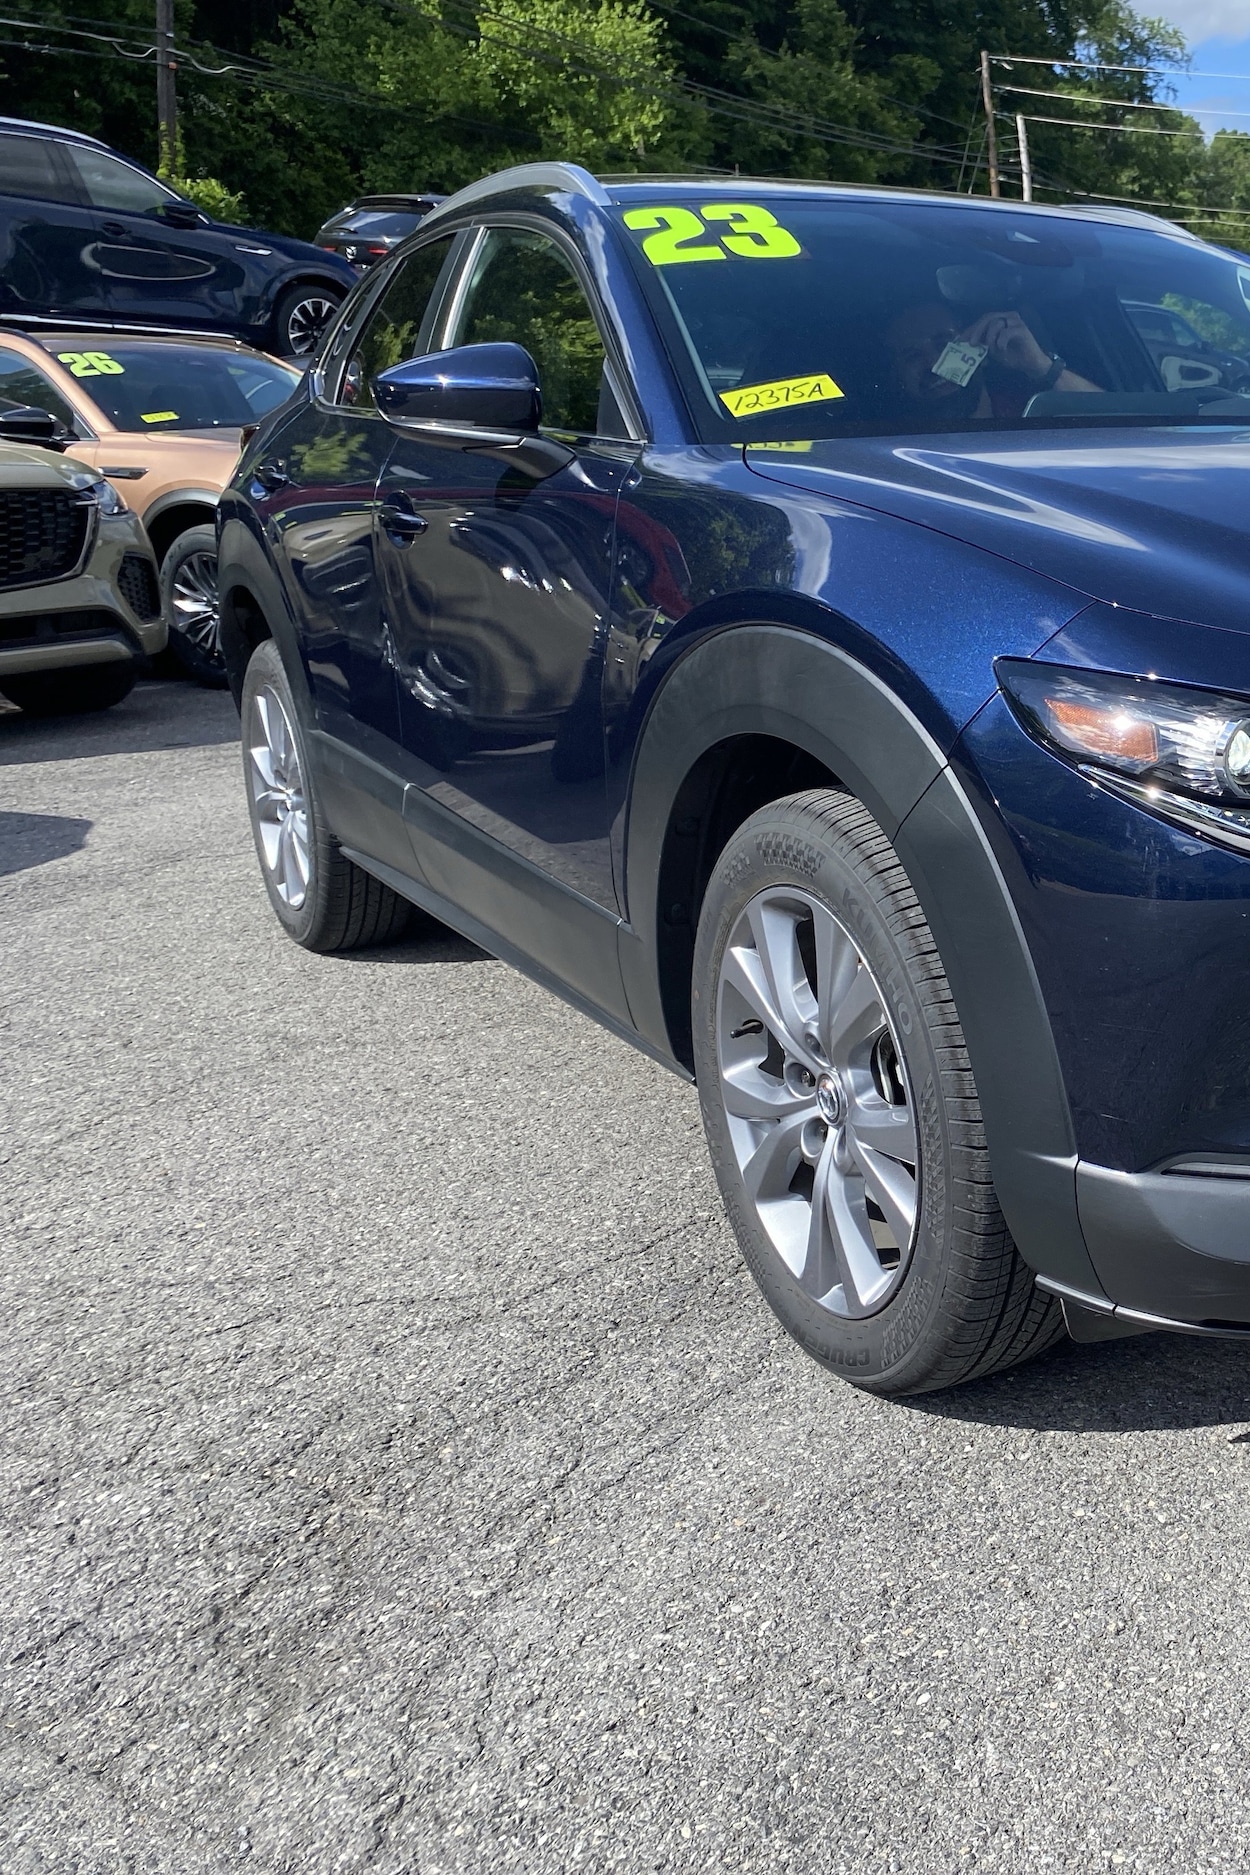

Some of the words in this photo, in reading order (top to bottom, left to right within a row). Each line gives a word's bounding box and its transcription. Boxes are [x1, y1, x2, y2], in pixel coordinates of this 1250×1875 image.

[623, 203, 802, 266] 23
[57, 351, 126, 378] 26
[734, 382, 825, 411] 12375A
